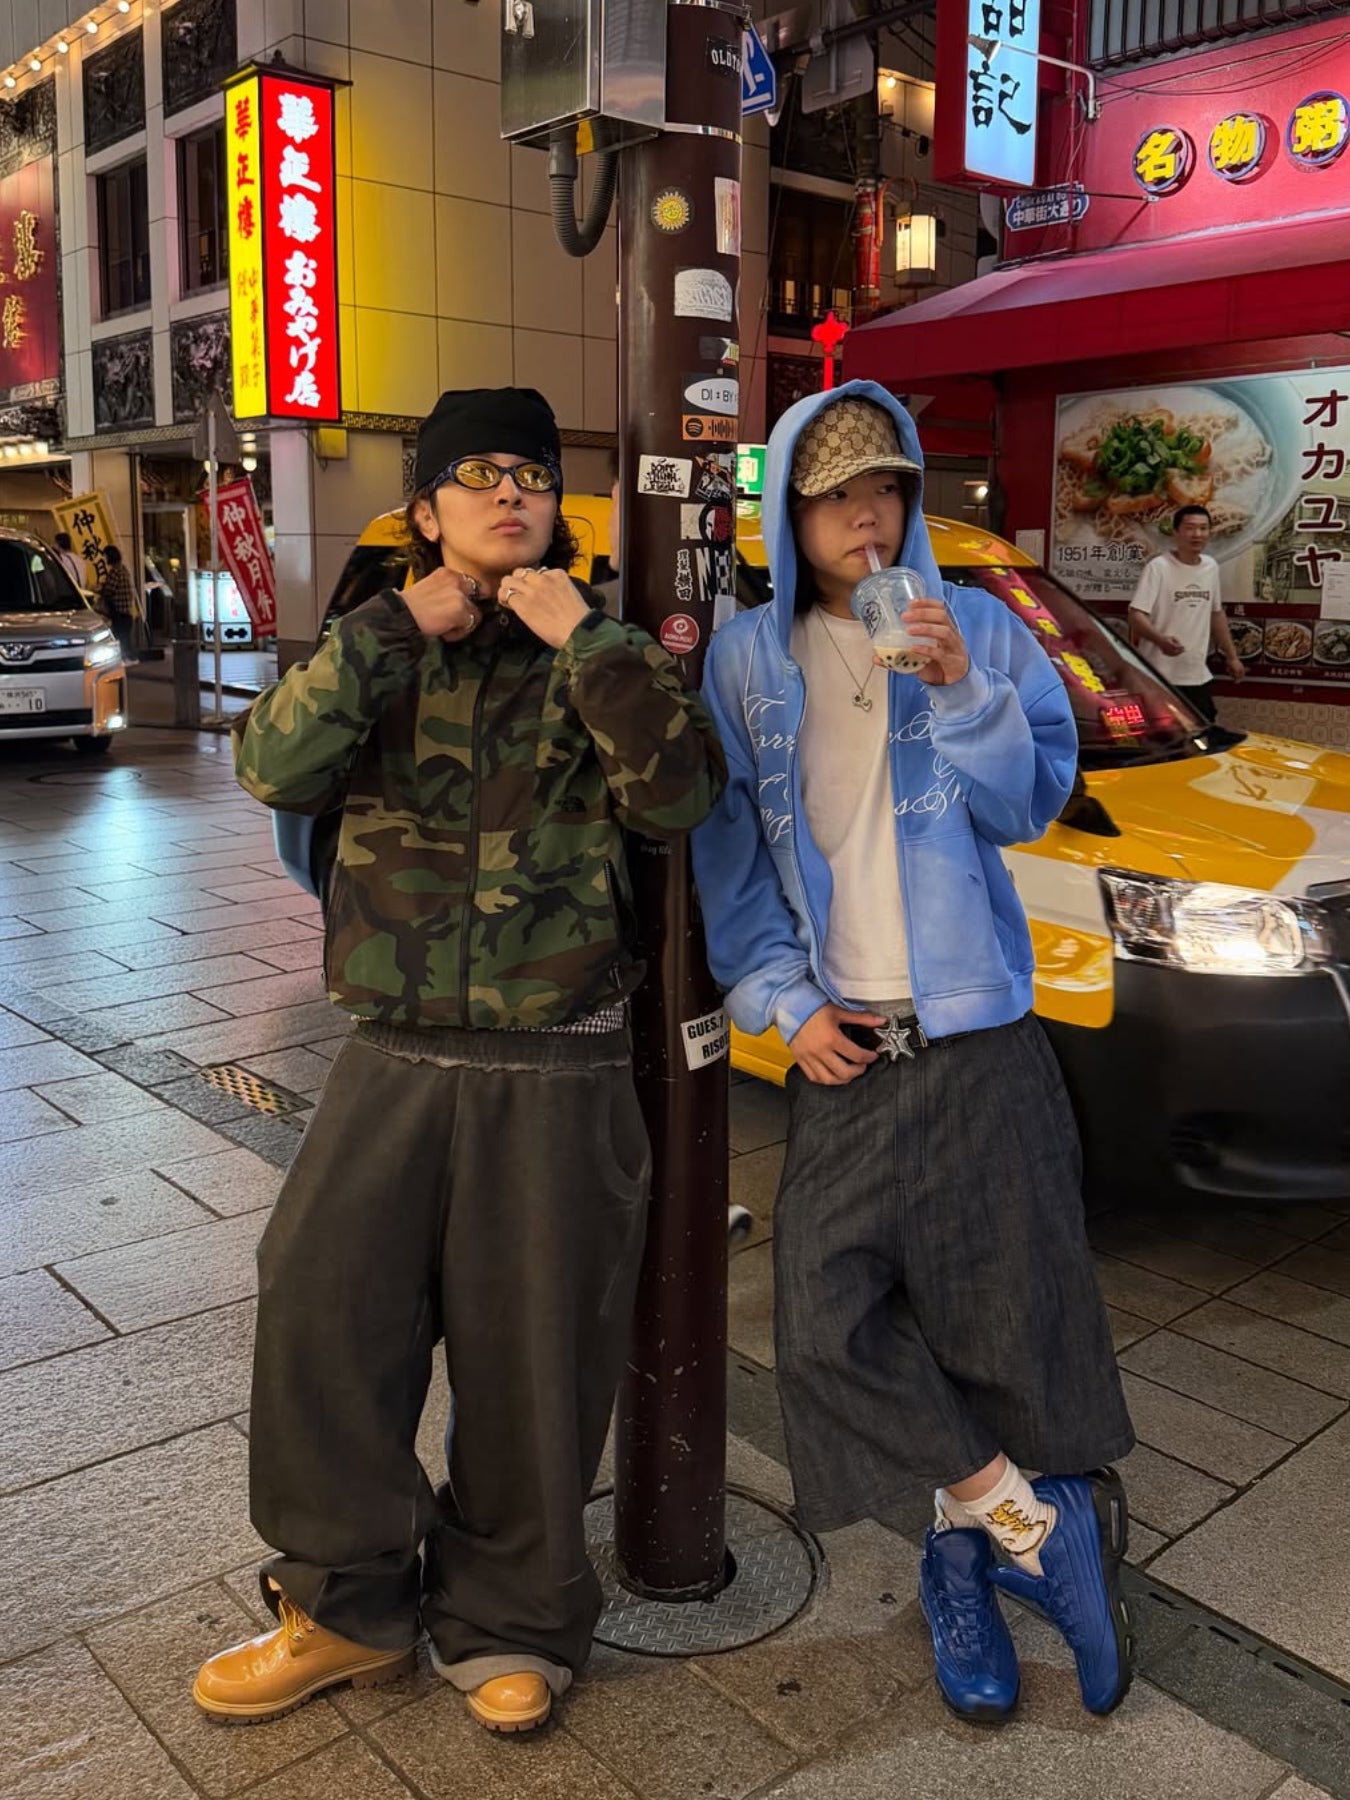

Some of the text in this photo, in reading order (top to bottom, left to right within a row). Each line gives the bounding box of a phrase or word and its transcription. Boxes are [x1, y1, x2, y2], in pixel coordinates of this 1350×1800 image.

[1135, 98, 1345, 183] 名物粥
[1296, 388, 1349, 585] オカユヤ
[1057, 543, 1144, 562] 1951年創業
